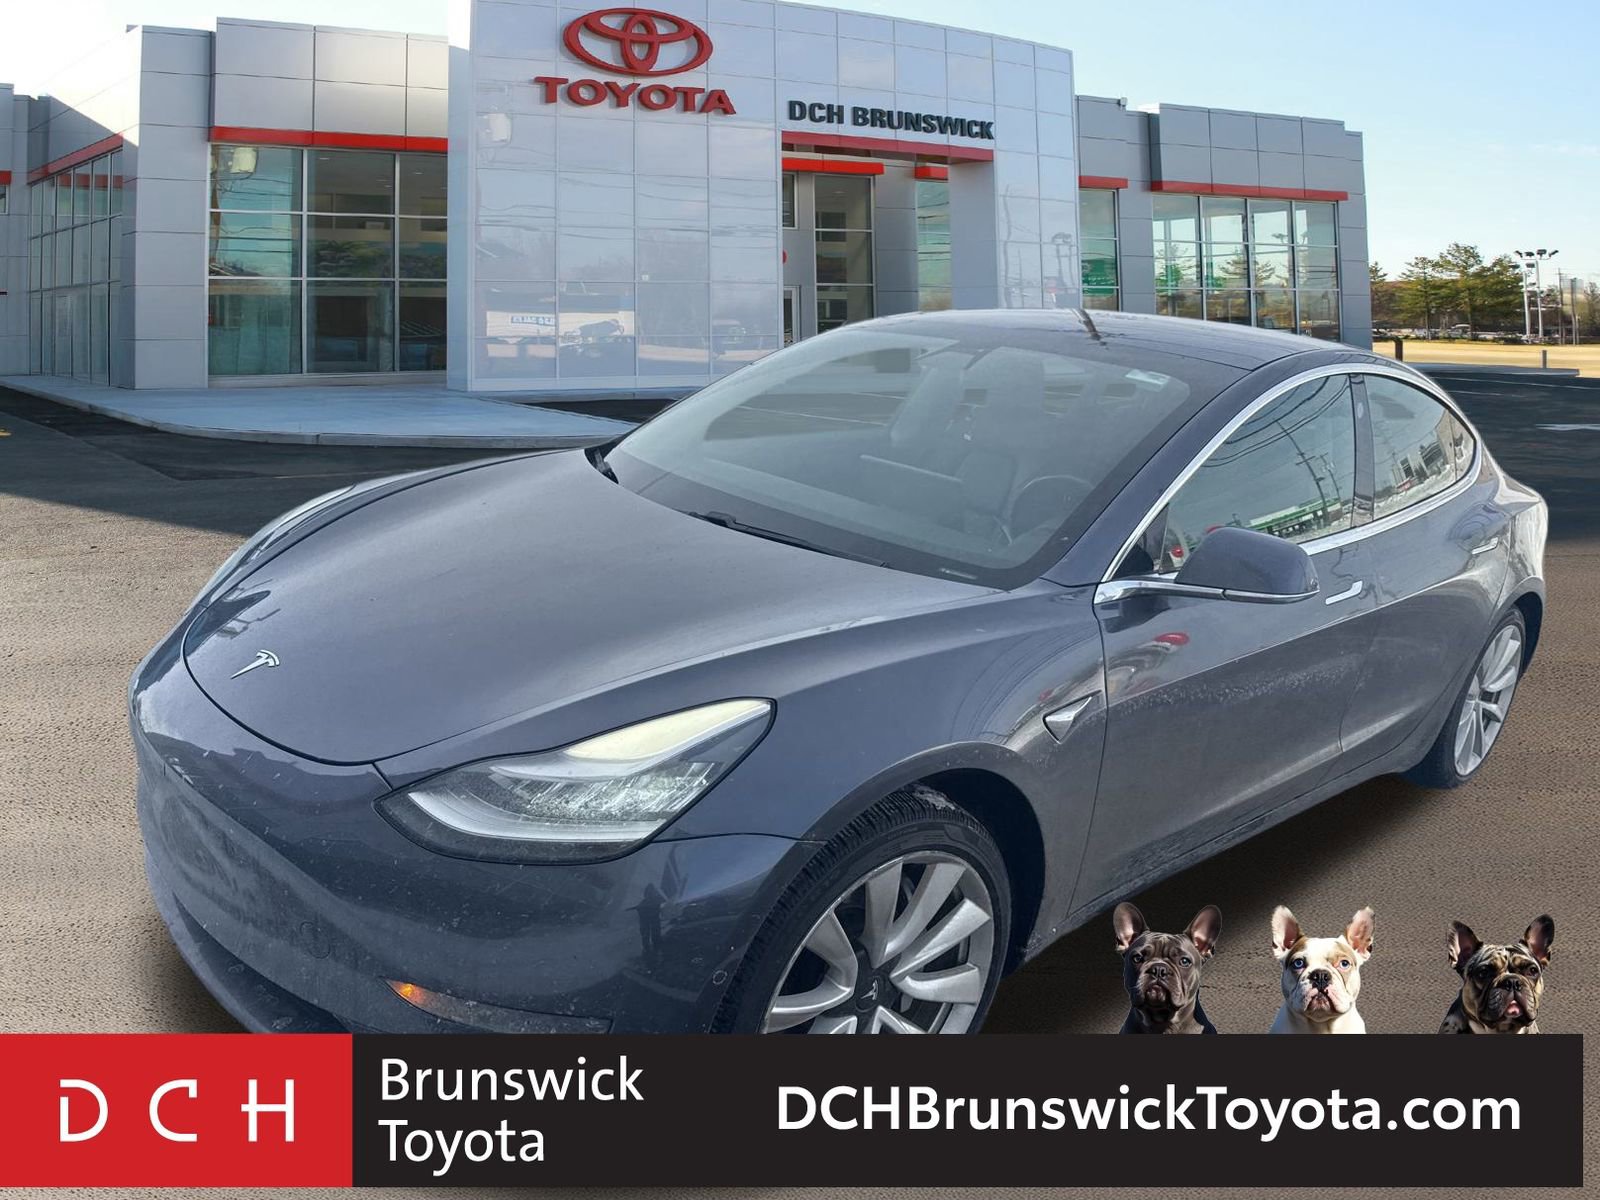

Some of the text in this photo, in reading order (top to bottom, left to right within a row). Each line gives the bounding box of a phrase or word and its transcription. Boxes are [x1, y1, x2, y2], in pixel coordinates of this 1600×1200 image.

[534, 76, 737, 115] TOYOTA
[788, 100, 994, 140] DCH BRUNSWICK
